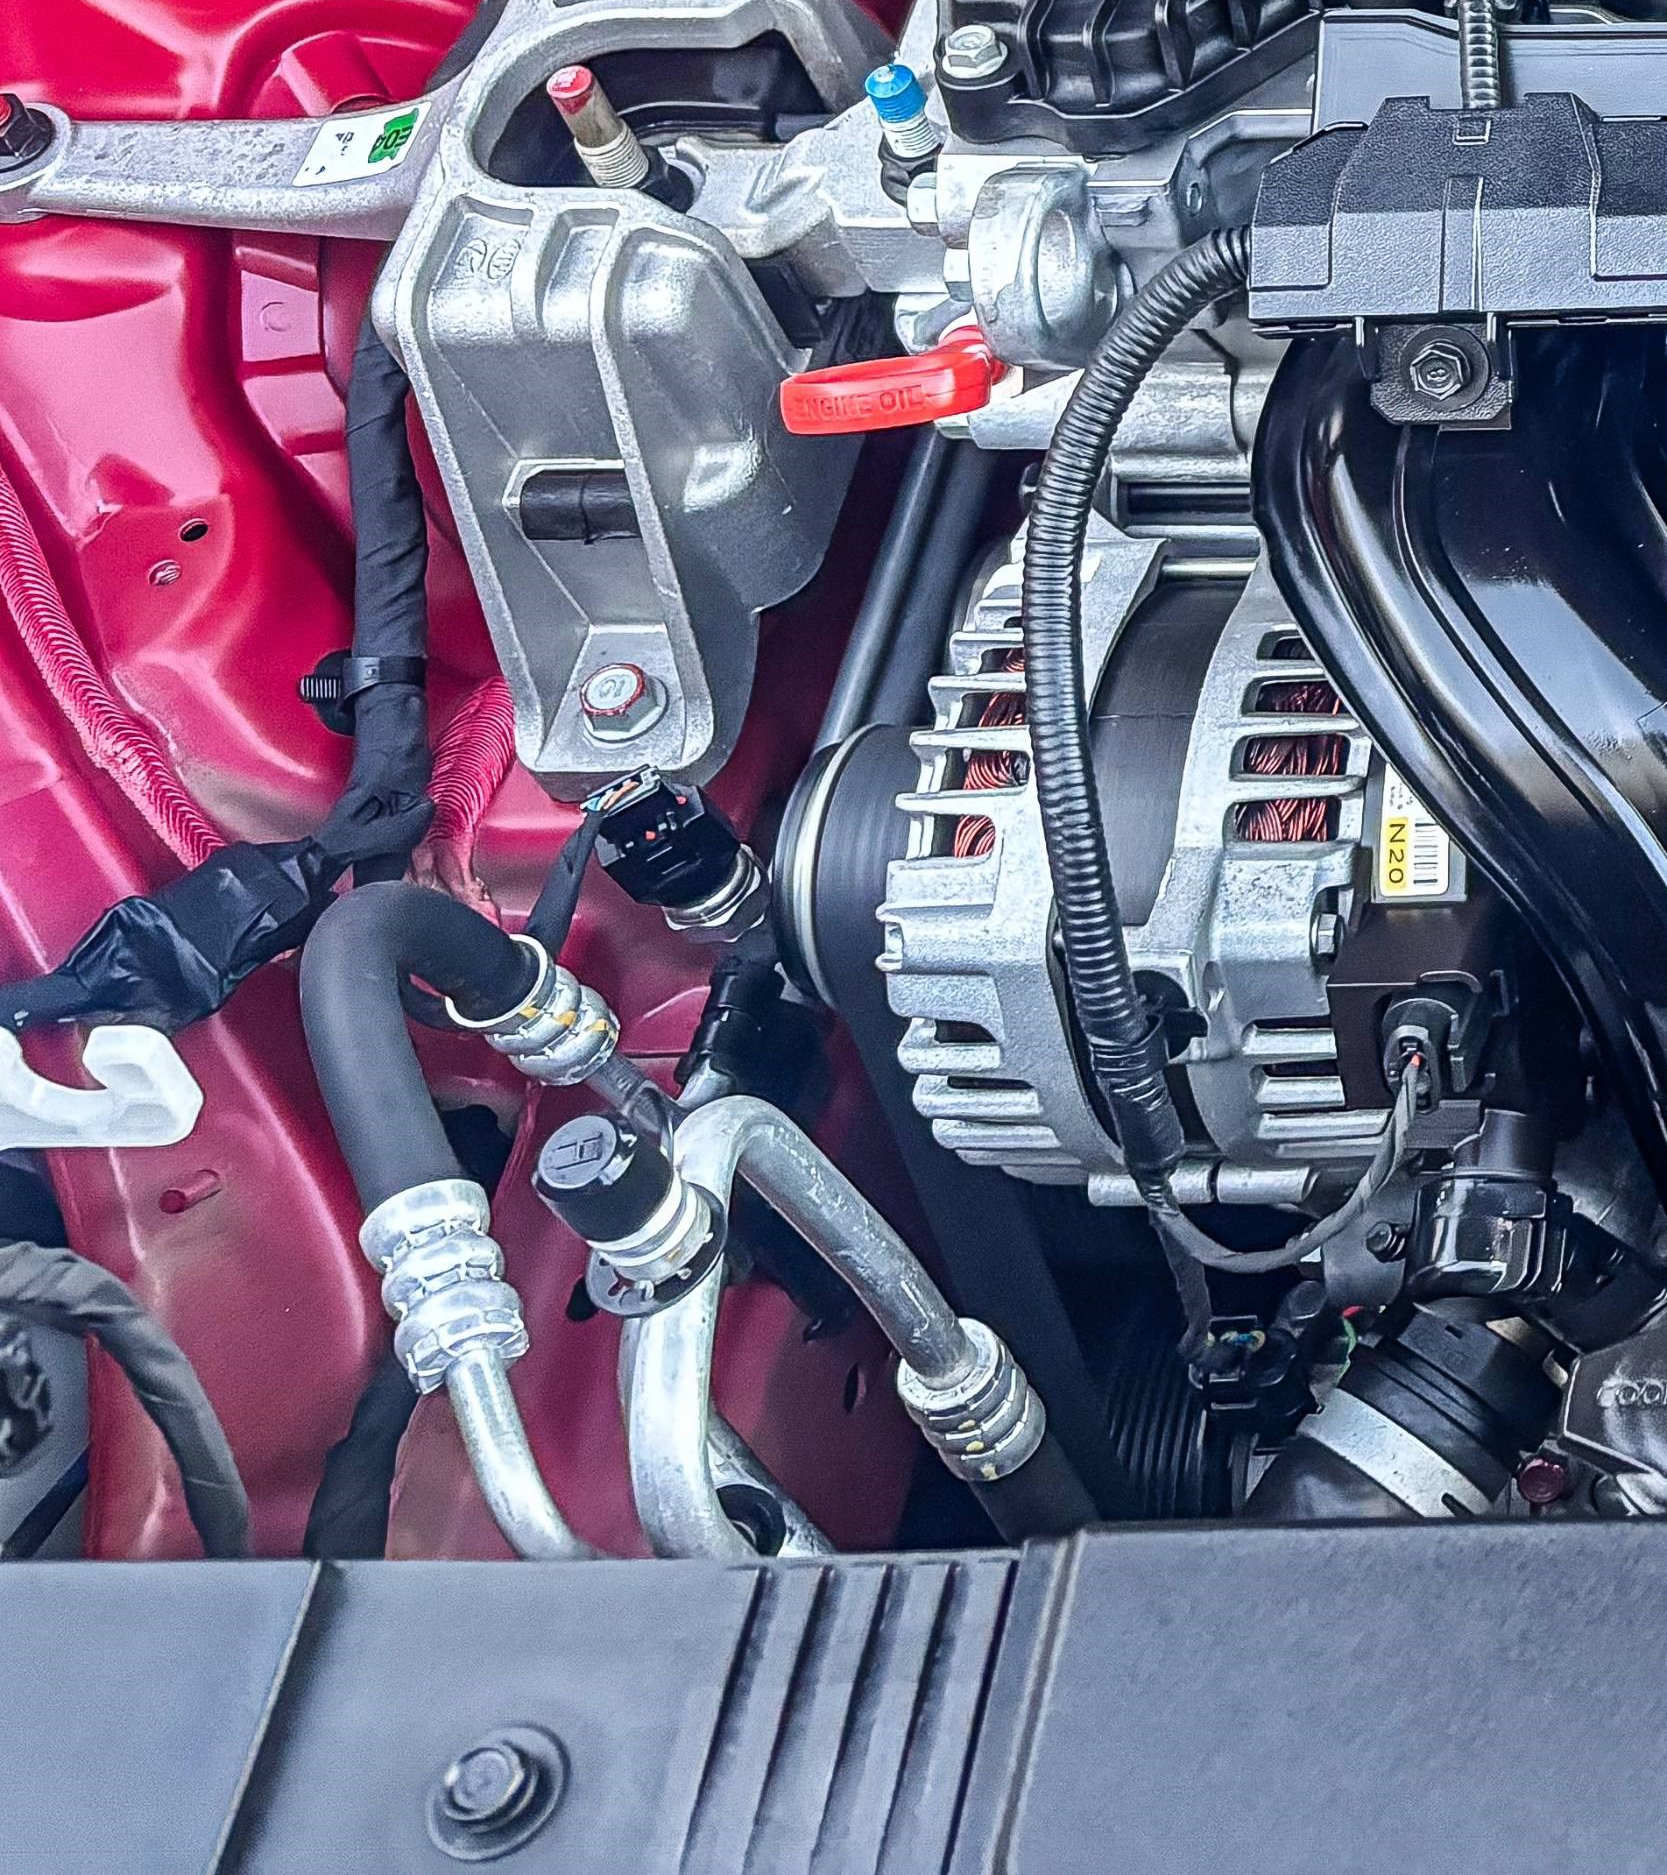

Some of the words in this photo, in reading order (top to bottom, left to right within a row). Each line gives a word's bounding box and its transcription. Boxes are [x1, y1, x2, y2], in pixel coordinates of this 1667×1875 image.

[795, 394, 872, 421] ENGINE
[878, 385, 923, 415] OIL
[1388, 823, 1406, 885] N20
